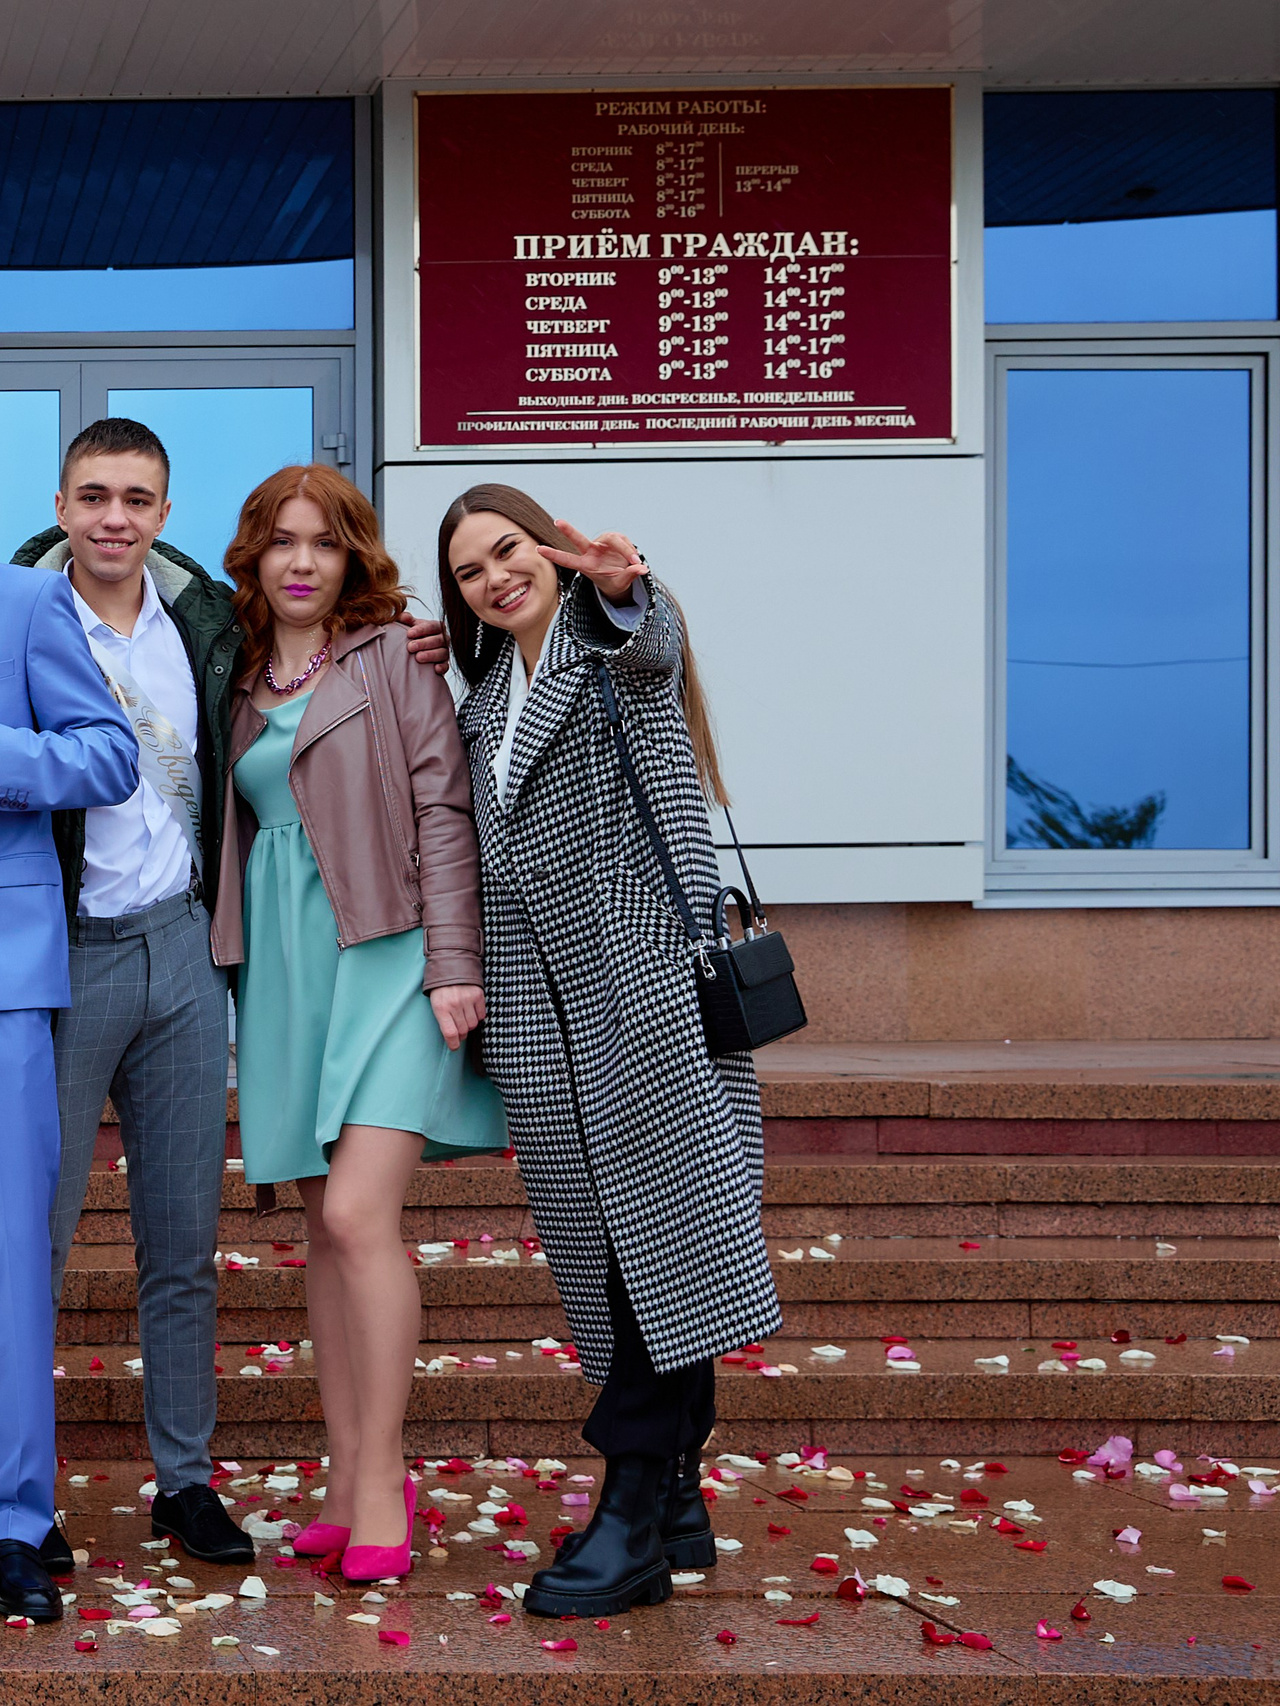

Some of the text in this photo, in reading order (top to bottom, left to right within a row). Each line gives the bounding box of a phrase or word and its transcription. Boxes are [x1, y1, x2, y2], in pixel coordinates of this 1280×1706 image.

[595, 99, 767, 116] РЕЖИМ РАБОТЫ:
[617, 121, 745, 137] РАБОЧИЙ ДЕНЬ:
[571, 145, 633, 157] ВТОРНИК
[570, 161, 614, 174] СРЕДА
[735, 164, 800, 176] ПЕРЕРЫВ
[571, 177, 630, 188] ЧЕТВЕРГ
[571, 192, 635, 205] ПЯТНИЦА
[571, 208, 631, 220] СУББОТА
[514, 228, 858, 262] ПРИЁМ ГРАЖДАН:
[525, 271, 617, 287] ВТОРНИК
[524, 295, 588, 313] СРЕДА
[525, 319, 611, 335] ЧЕТВЕРГ
[525, 343, 619, 360] ПЯТНИЦА
[525, 367, 613, 383] СУББОТА
[518, 390, 855, 408] ВЫХОДНЫЕ ДНИ: ВОСКРЕСЕНЬЕ, ПОНЕДЕЛЬНИК
[600, 419, 640, 432] ДЕНЬ:
[645, 415, 738, 431] ПОСЛЕДНИЙ
[810, 415, 853, 430] ДЕНЬ
[853, 414, 917, 428] МЕСЯЦА
